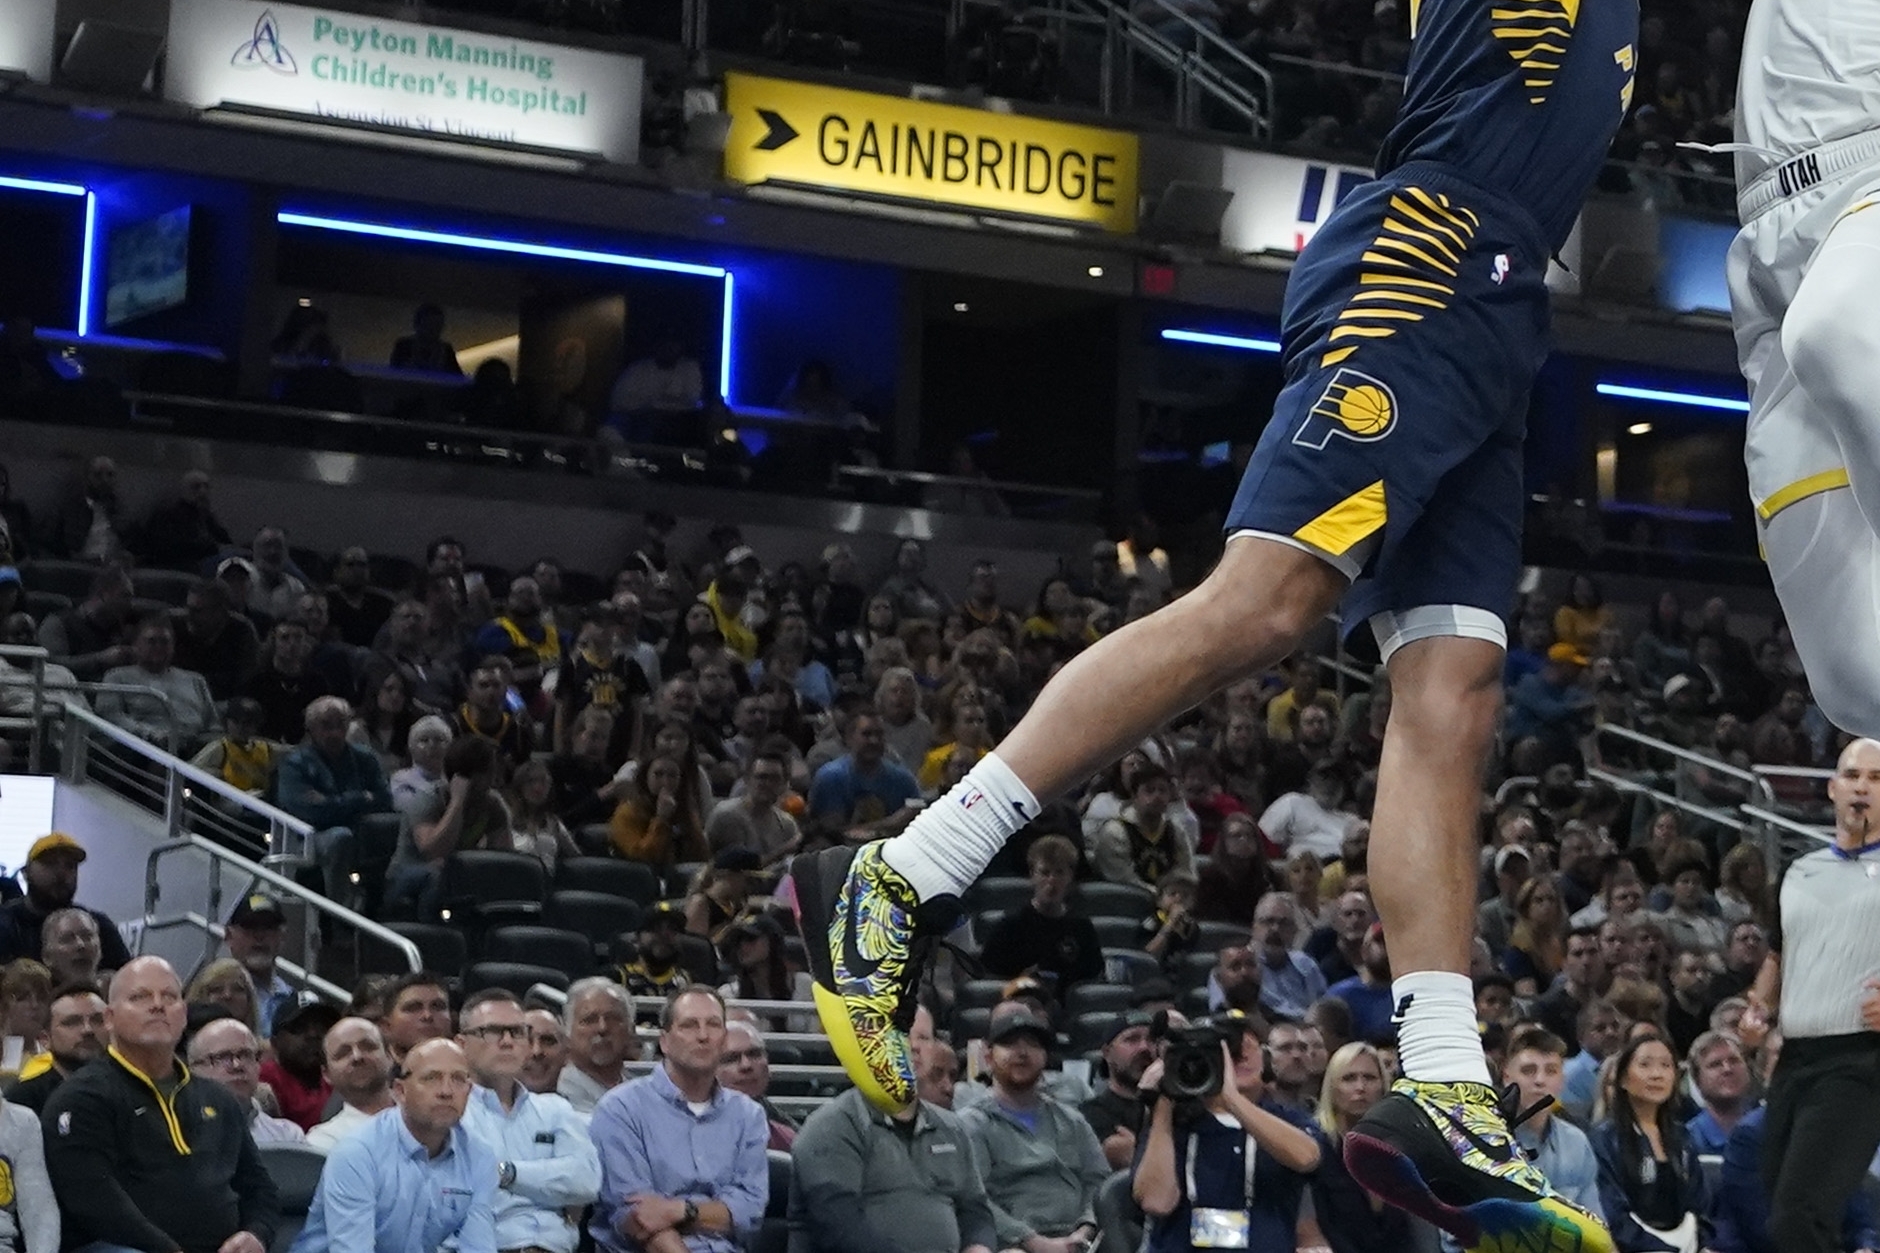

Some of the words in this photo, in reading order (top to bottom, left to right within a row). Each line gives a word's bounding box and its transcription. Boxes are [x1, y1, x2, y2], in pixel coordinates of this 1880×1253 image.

[312, 15, 417, 55] Peyton
[426, 32, 554, 80] Manning
[310, 53, 457, 98] Children's
[466, 75, 587, 116] Hospital
[817, 113, 1117, 208] GAINBRIDGE
[1778, 153, 1822, 196] UTAH
